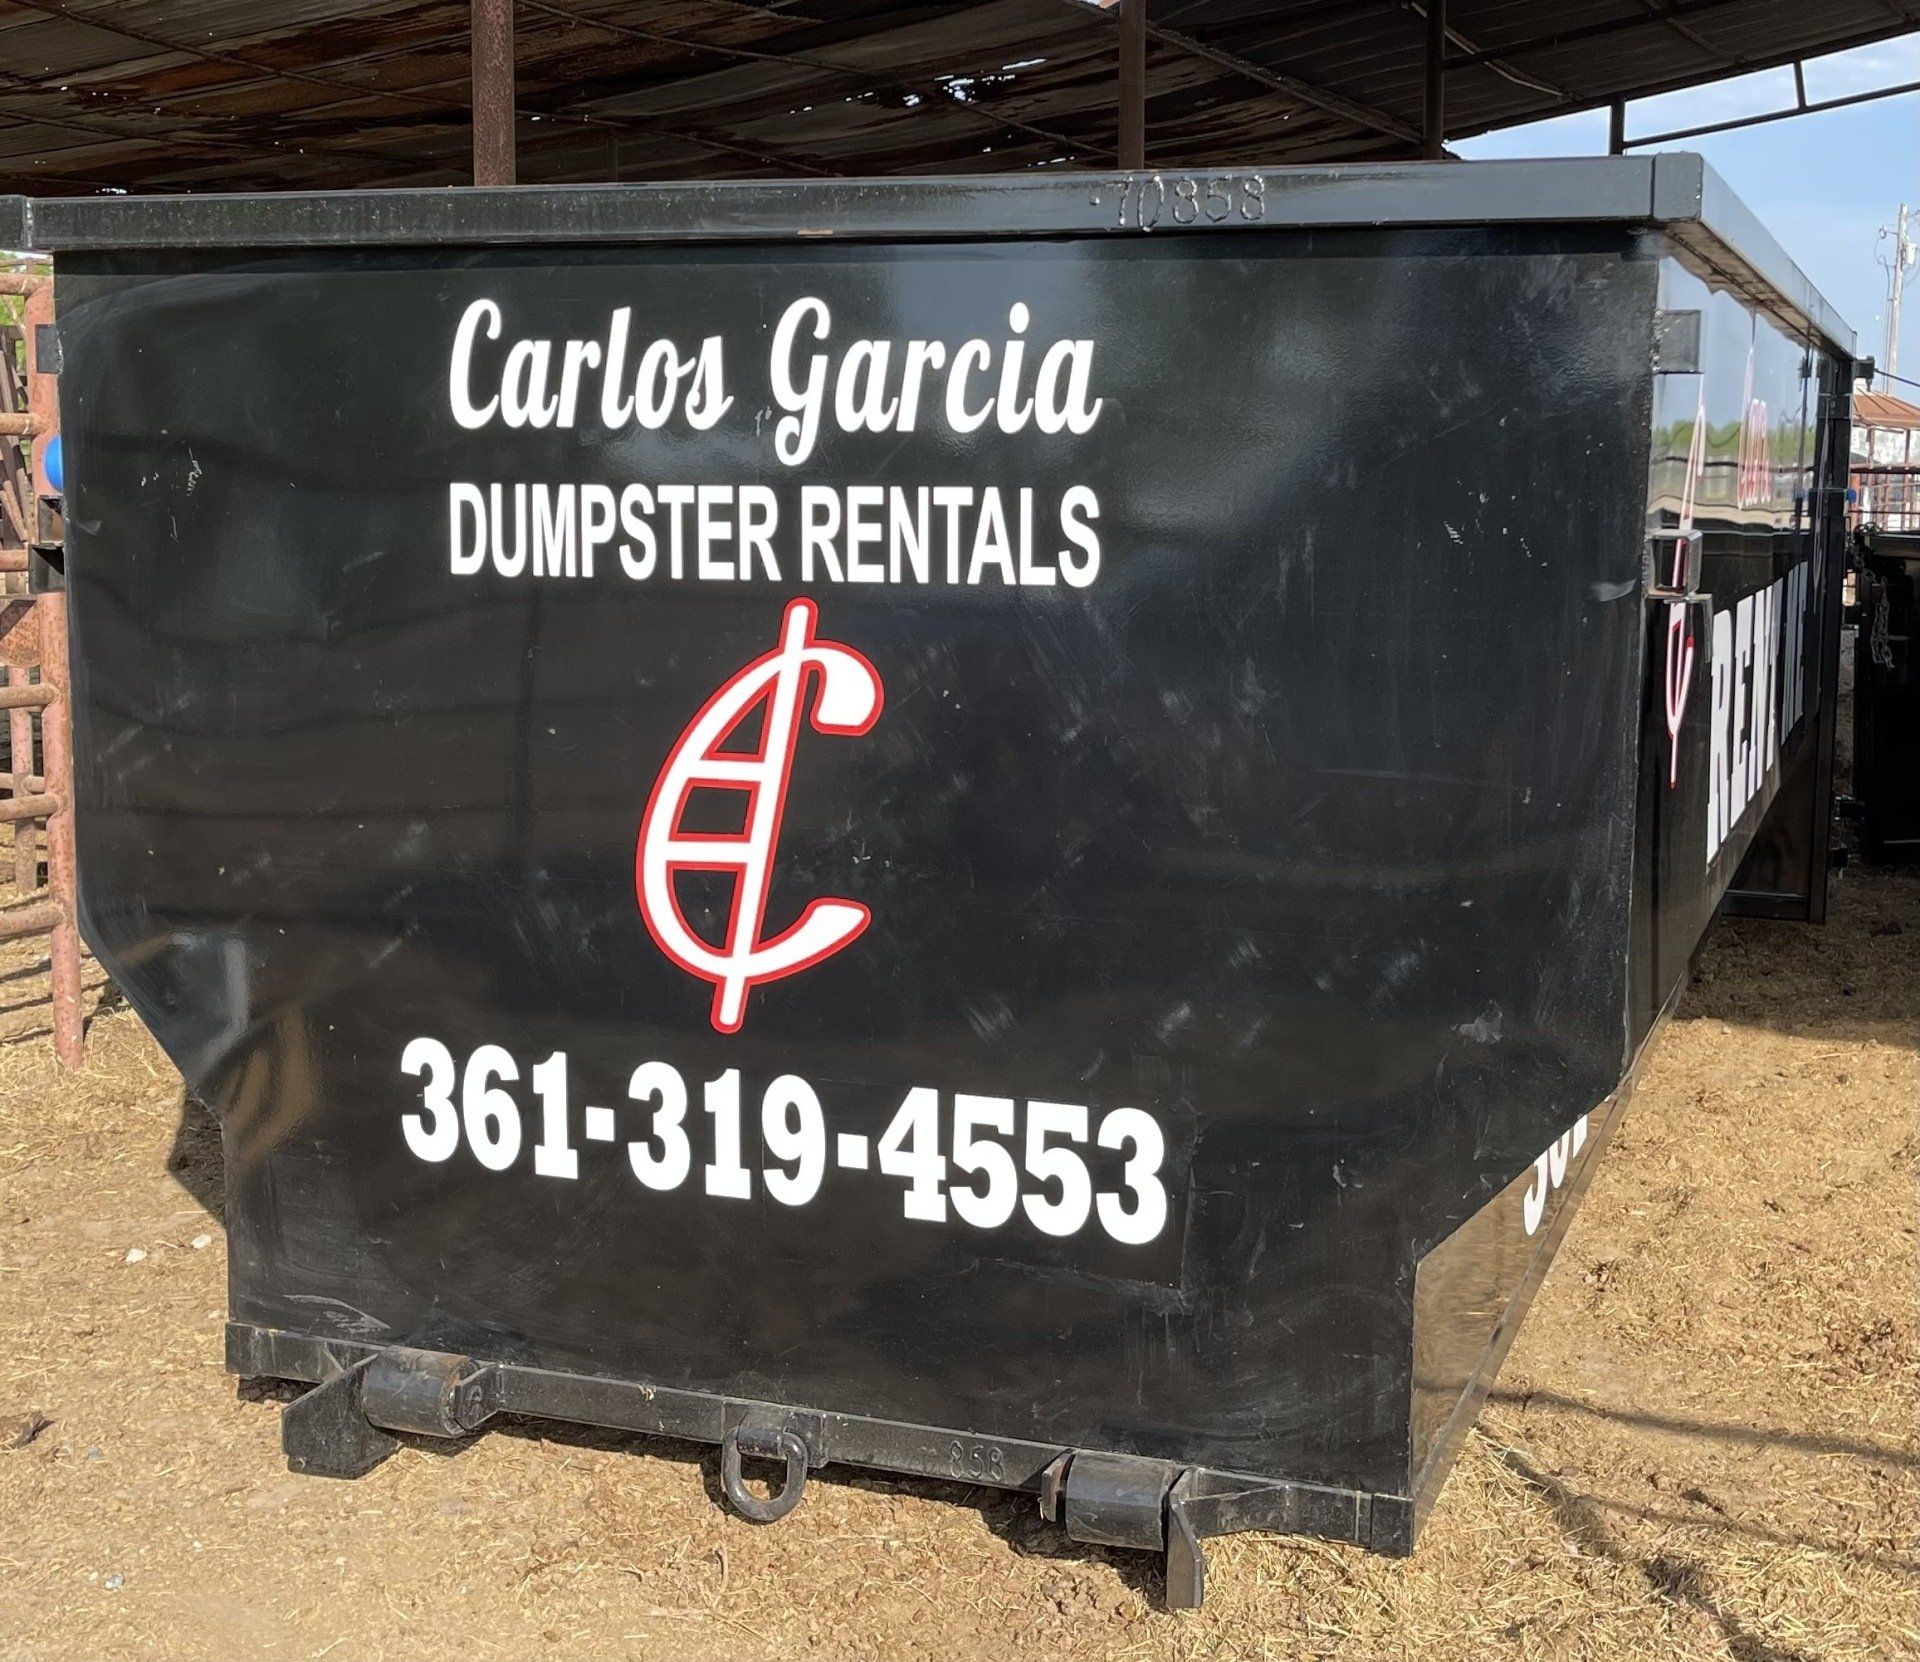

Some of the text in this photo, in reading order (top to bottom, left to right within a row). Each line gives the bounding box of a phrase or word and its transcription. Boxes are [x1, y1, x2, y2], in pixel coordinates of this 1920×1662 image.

[449, 296, 1104, 468] Carlos Garcia
[449, 482, 1102, 588] DUMPSTER RENTALS
[400, 1037, 1167, 1245] 361-319-4553
[948, 1439, 1004, 1482] 858
